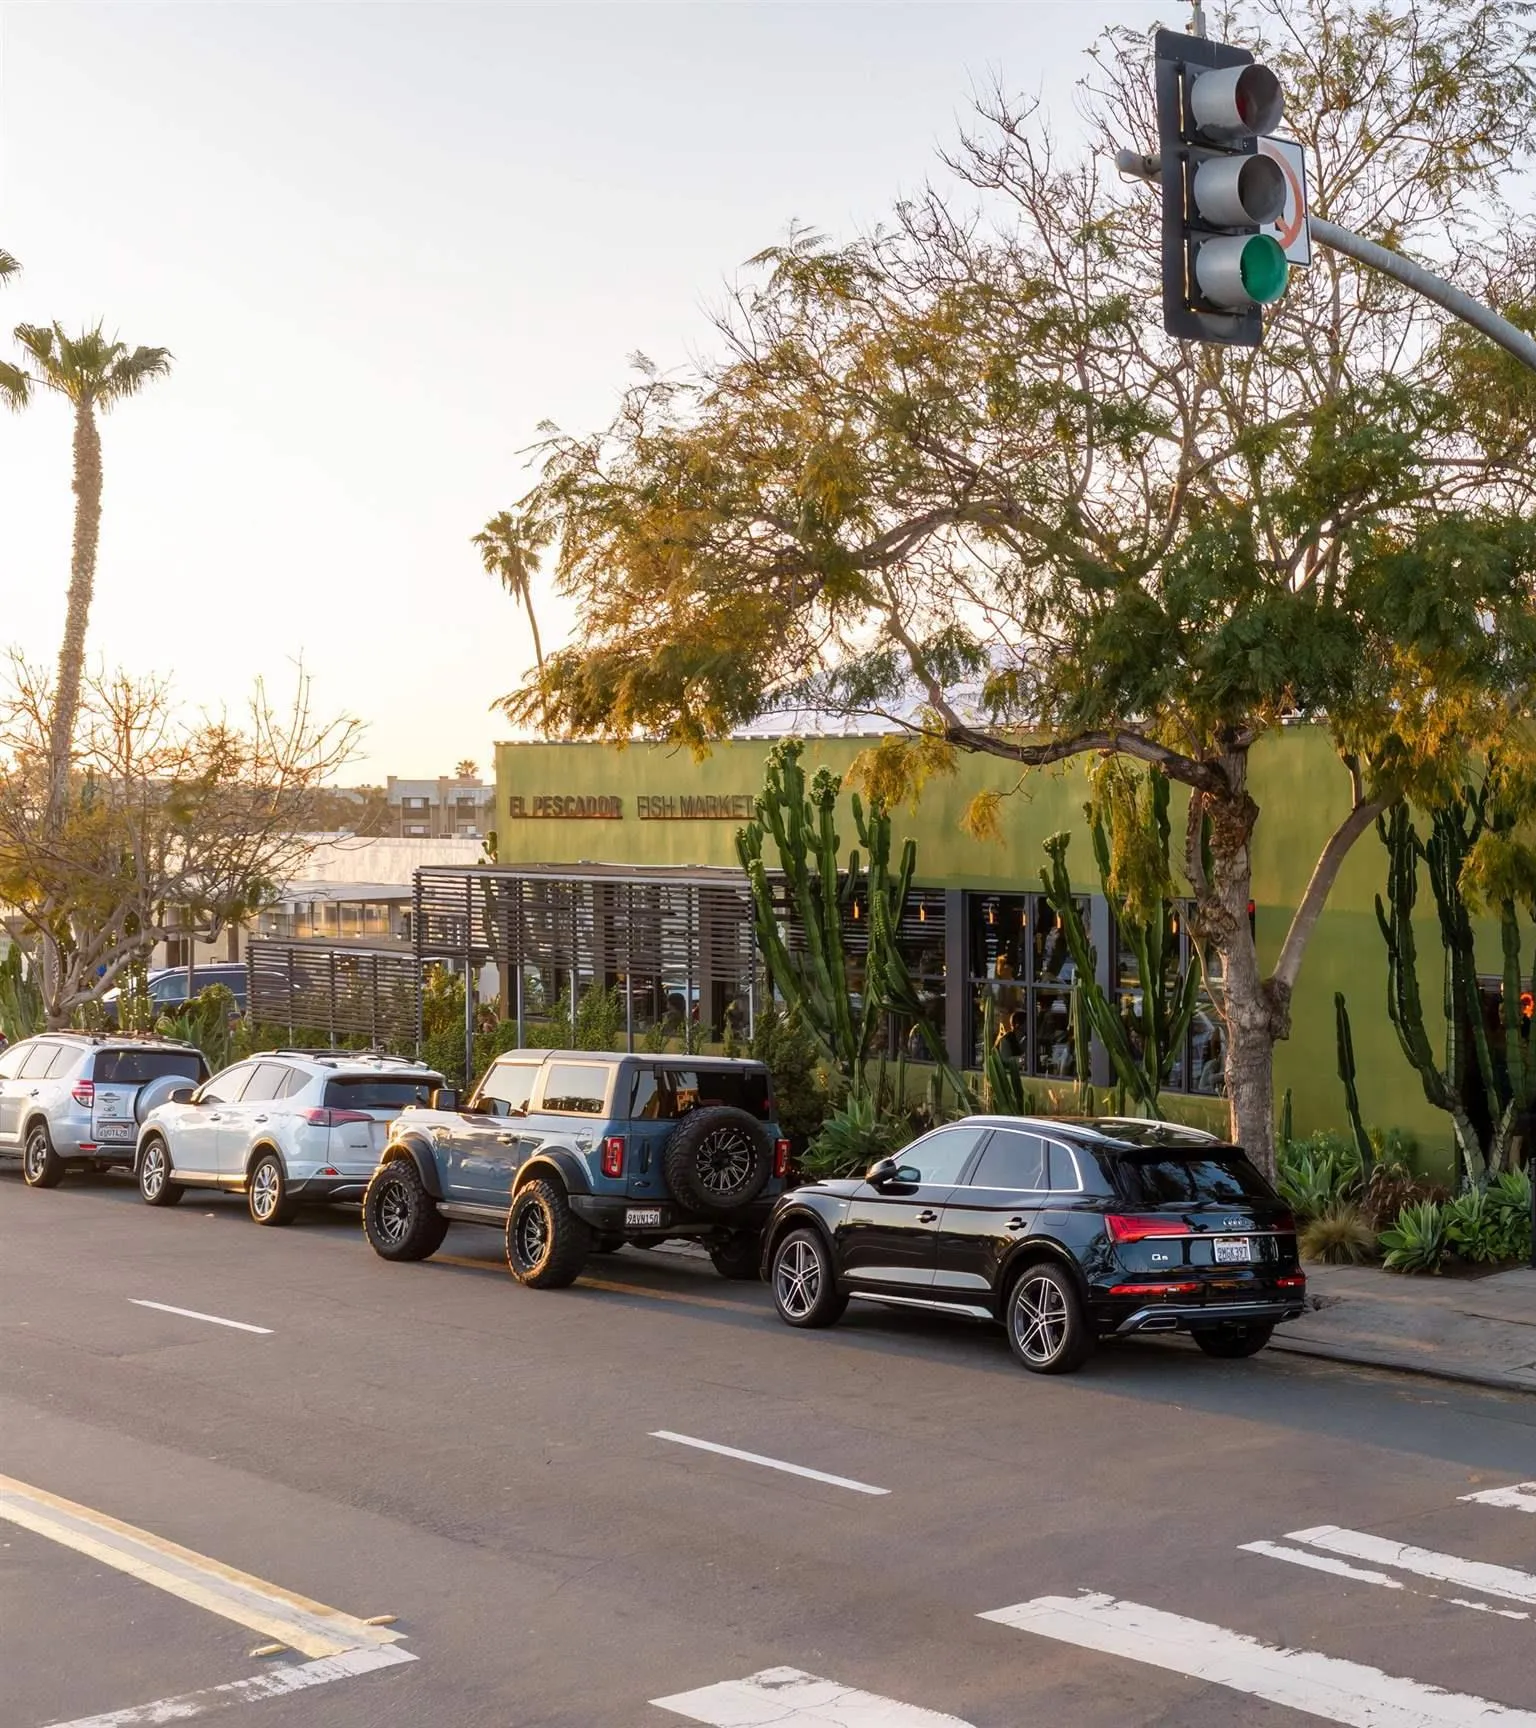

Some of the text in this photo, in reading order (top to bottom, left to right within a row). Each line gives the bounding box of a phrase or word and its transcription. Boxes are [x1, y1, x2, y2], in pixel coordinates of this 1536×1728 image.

[509, 795, 756, 818] EL PESCADOR FISH MARKET
